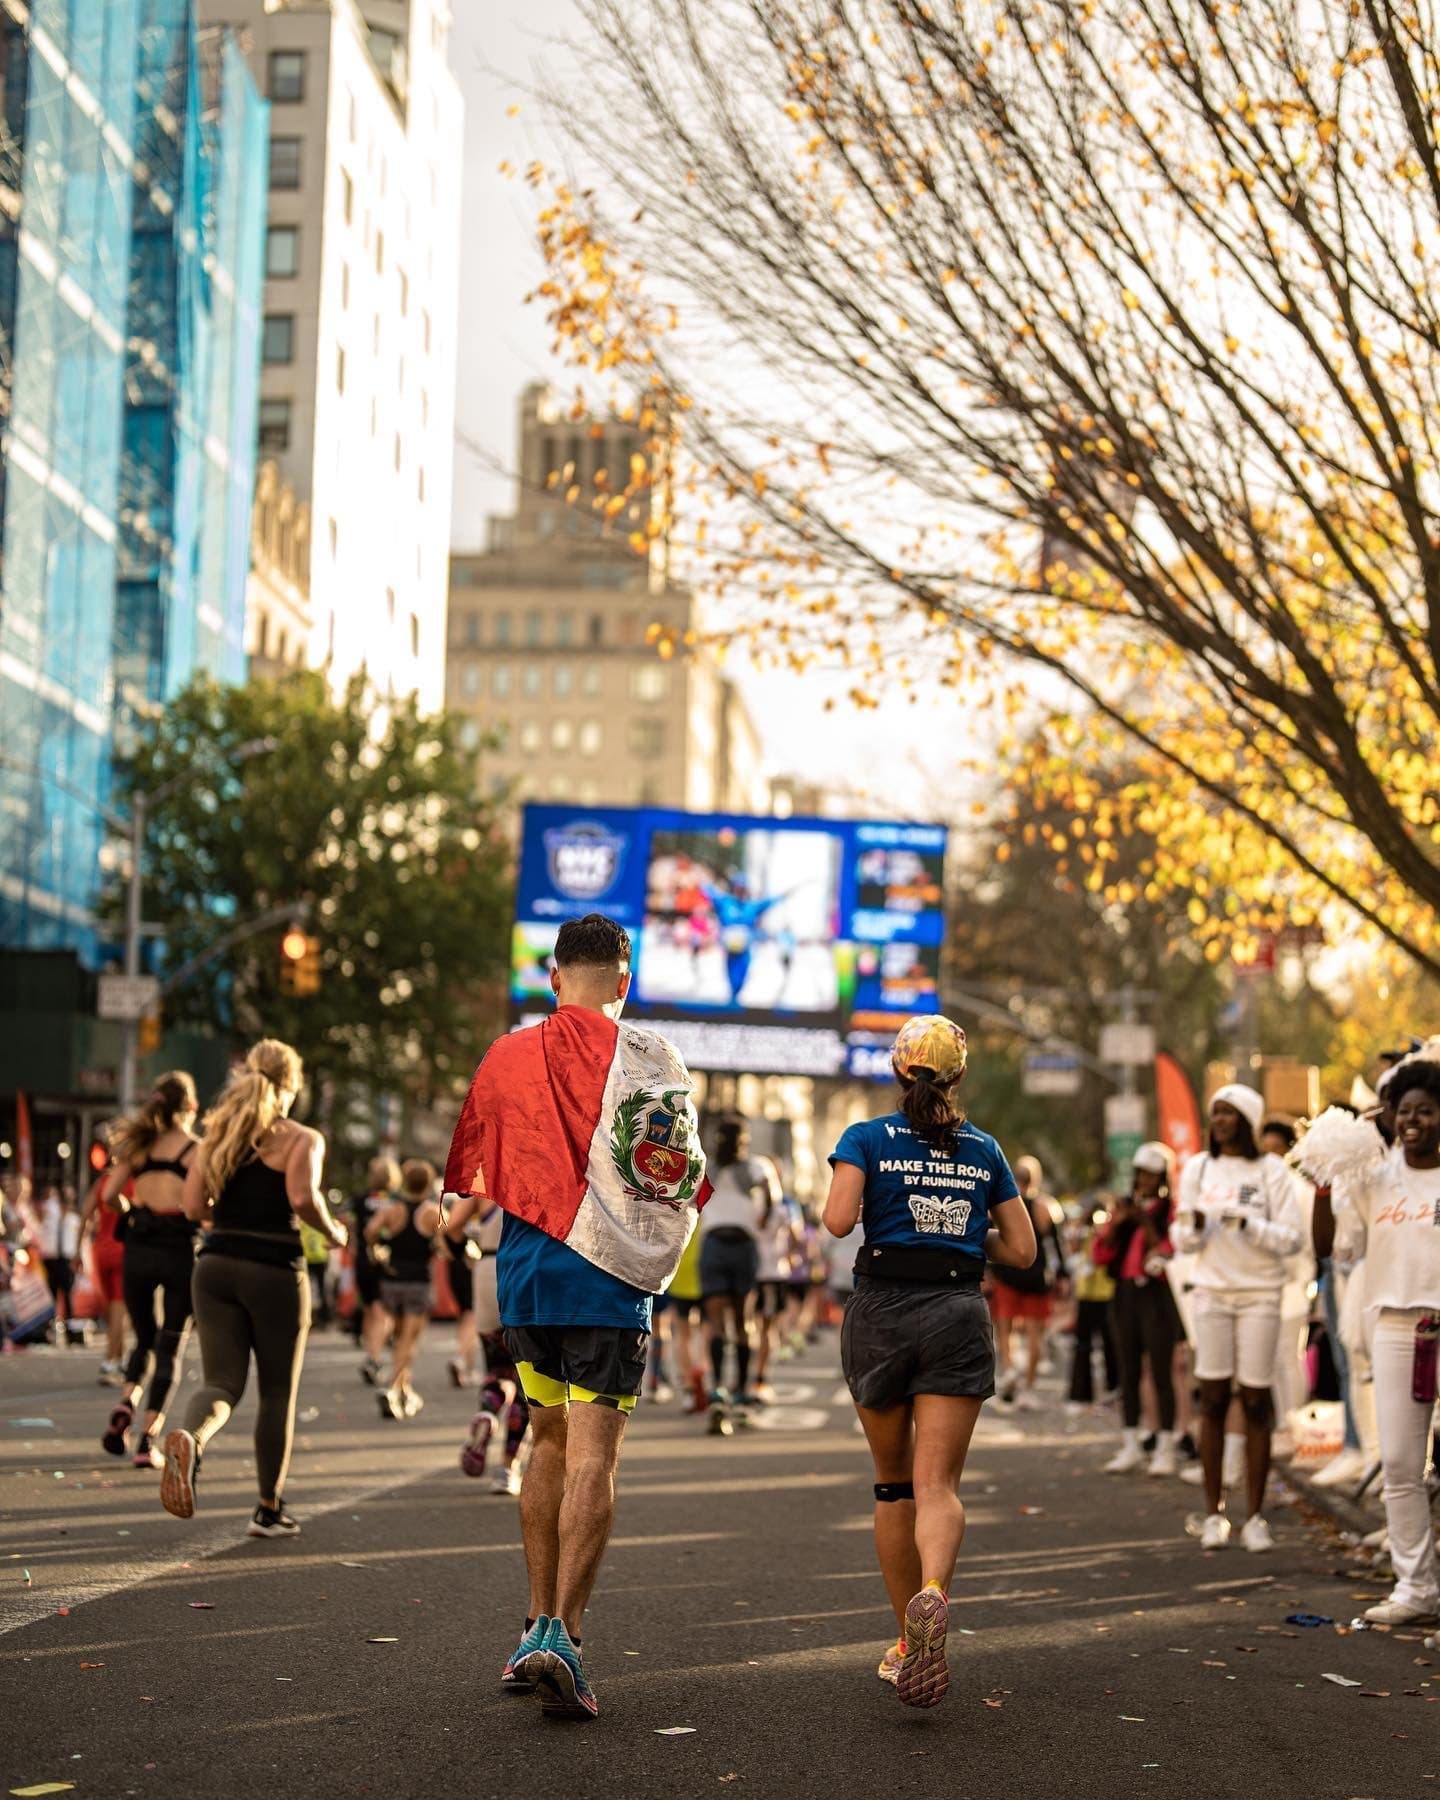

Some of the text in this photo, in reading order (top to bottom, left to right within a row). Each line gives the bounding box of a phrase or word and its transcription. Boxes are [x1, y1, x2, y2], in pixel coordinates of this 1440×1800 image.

[929, 1149, 951, 1159] WE
[879, 1160, 991, 1182] MAKE THE ROAD
[904, 1175, 976, 1190] BY RUNNING!
[915, 1202, 939, 1223] HERE
[946, 1206, 968, 1226] STAY
[1375, 1196, 1435, 1225] 26.2
